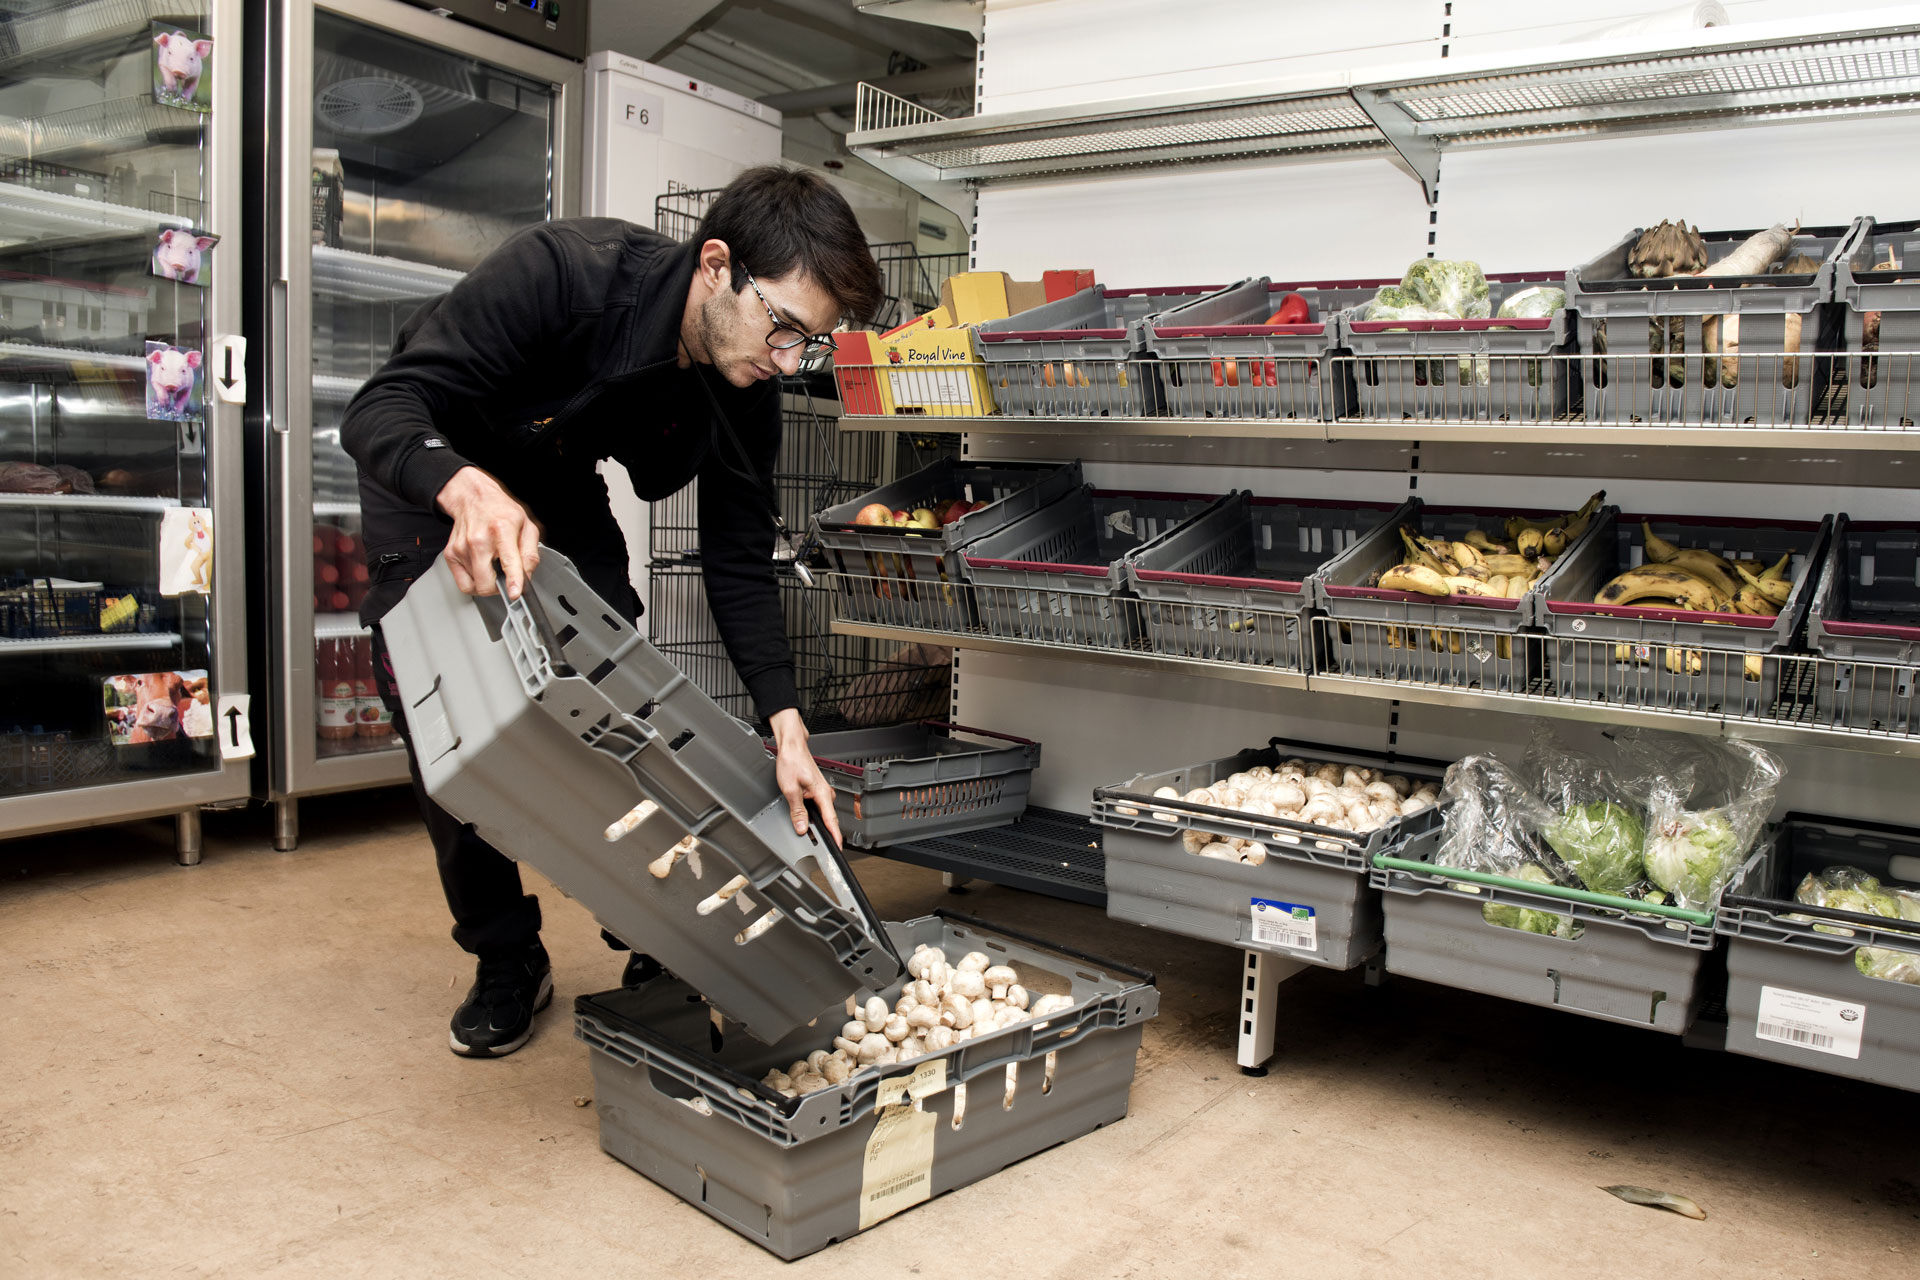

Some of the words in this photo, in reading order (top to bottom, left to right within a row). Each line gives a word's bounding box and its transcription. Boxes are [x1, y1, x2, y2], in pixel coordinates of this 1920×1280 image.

[626, 104, 635, 120] F
[640, 108, 649, 125] 6
[908, 345, 940, 364] Royal
[942, 347, 966, 361] Vine
[919, 1068, 936, 1080] 1330
